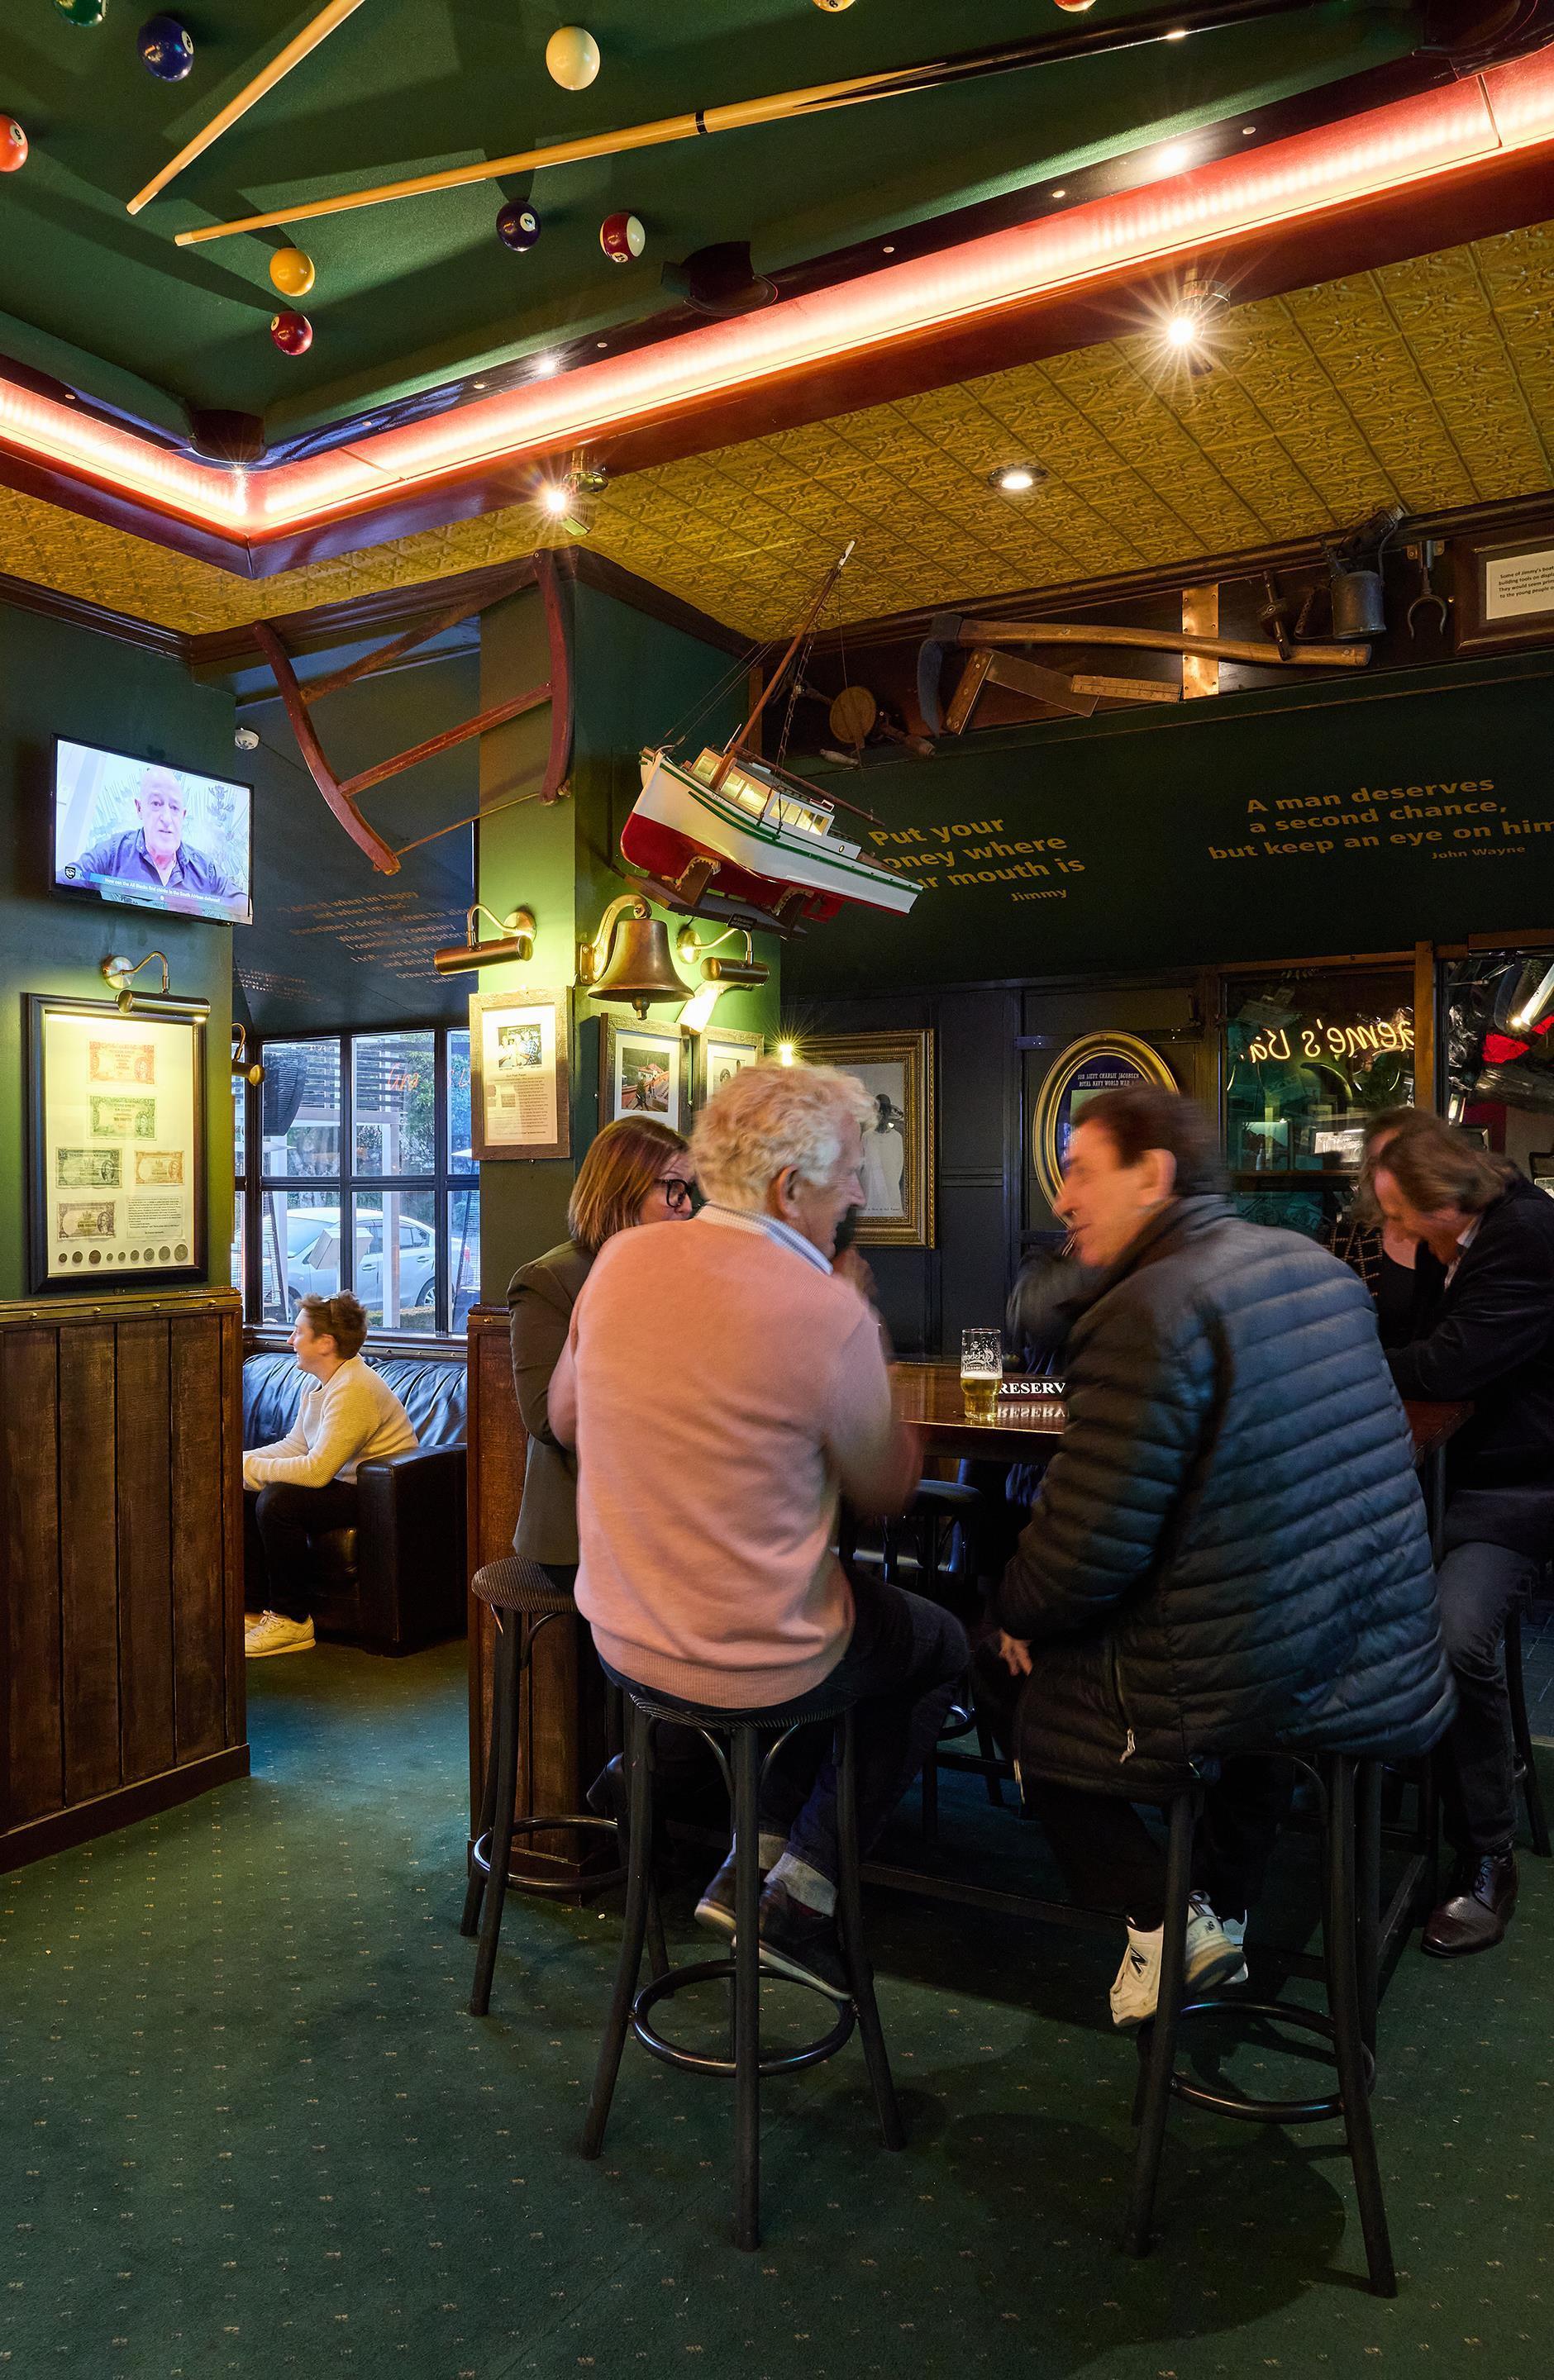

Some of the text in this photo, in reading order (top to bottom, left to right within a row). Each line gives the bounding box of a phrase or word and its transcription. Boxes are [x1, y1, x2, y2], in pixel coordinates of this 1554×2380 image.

[1247, 779, 1494, 813] A man deserves
[1249, 800, 1507, 833] a second chance,
[868, 818, 1005, 846] Put your
[1208, 845, 1258, 859] but
[1264, 839, 1334, 854] keep
[1344, 835, 1380, 848] an
[1390, 831, 1442, 846] eye
[1453, 826, 1491, 839] on
[882, 837, 1068, 868] oney where
[1431, 845, 1526, 859] John Wayne
[946, 860, 1051, 886] mouth
[1053, 857, 1086, 873] is
[1010, 889, 1068, 902] Jimmy
[999, 1382, 1065, 1394] RESERV
